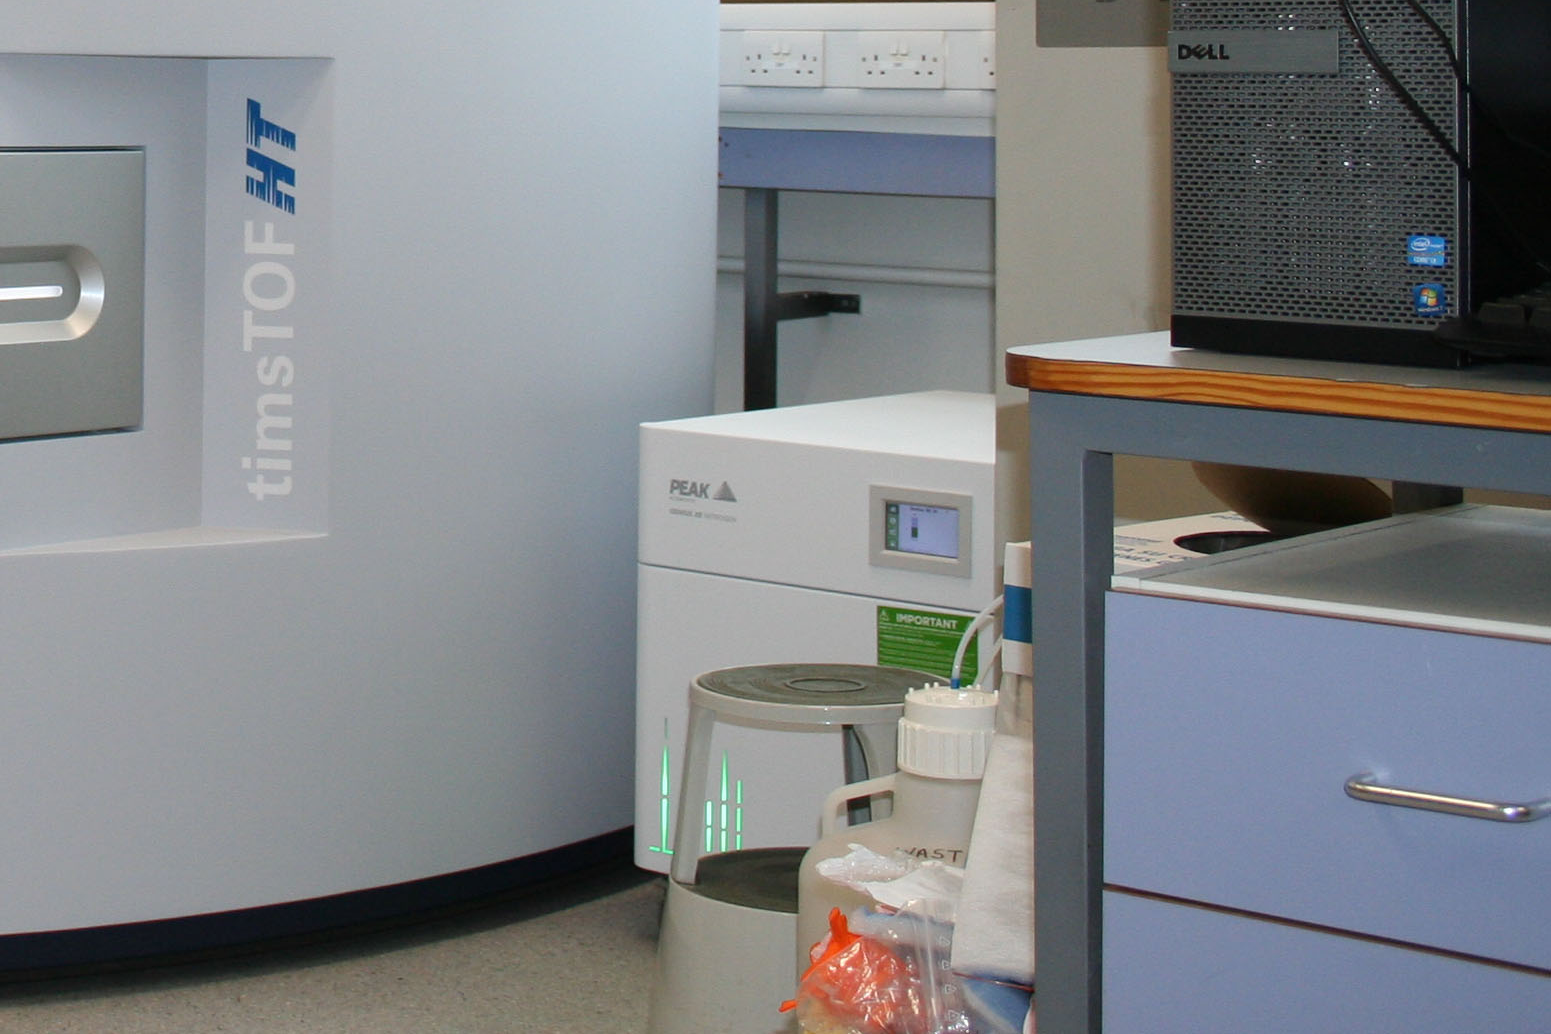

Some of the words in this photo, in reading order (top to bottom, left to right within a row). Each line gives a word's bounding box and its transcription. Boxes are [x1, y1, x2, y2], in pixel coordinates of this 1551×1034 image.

[1177, 44, 1230, 60] DELL
[246, 96, 297, 216] HT
[242, 219, 297, 503] timsTOF
[669, 478, 711, 499] PEAK
[895, 612, 958, 630] IMPORTANT
